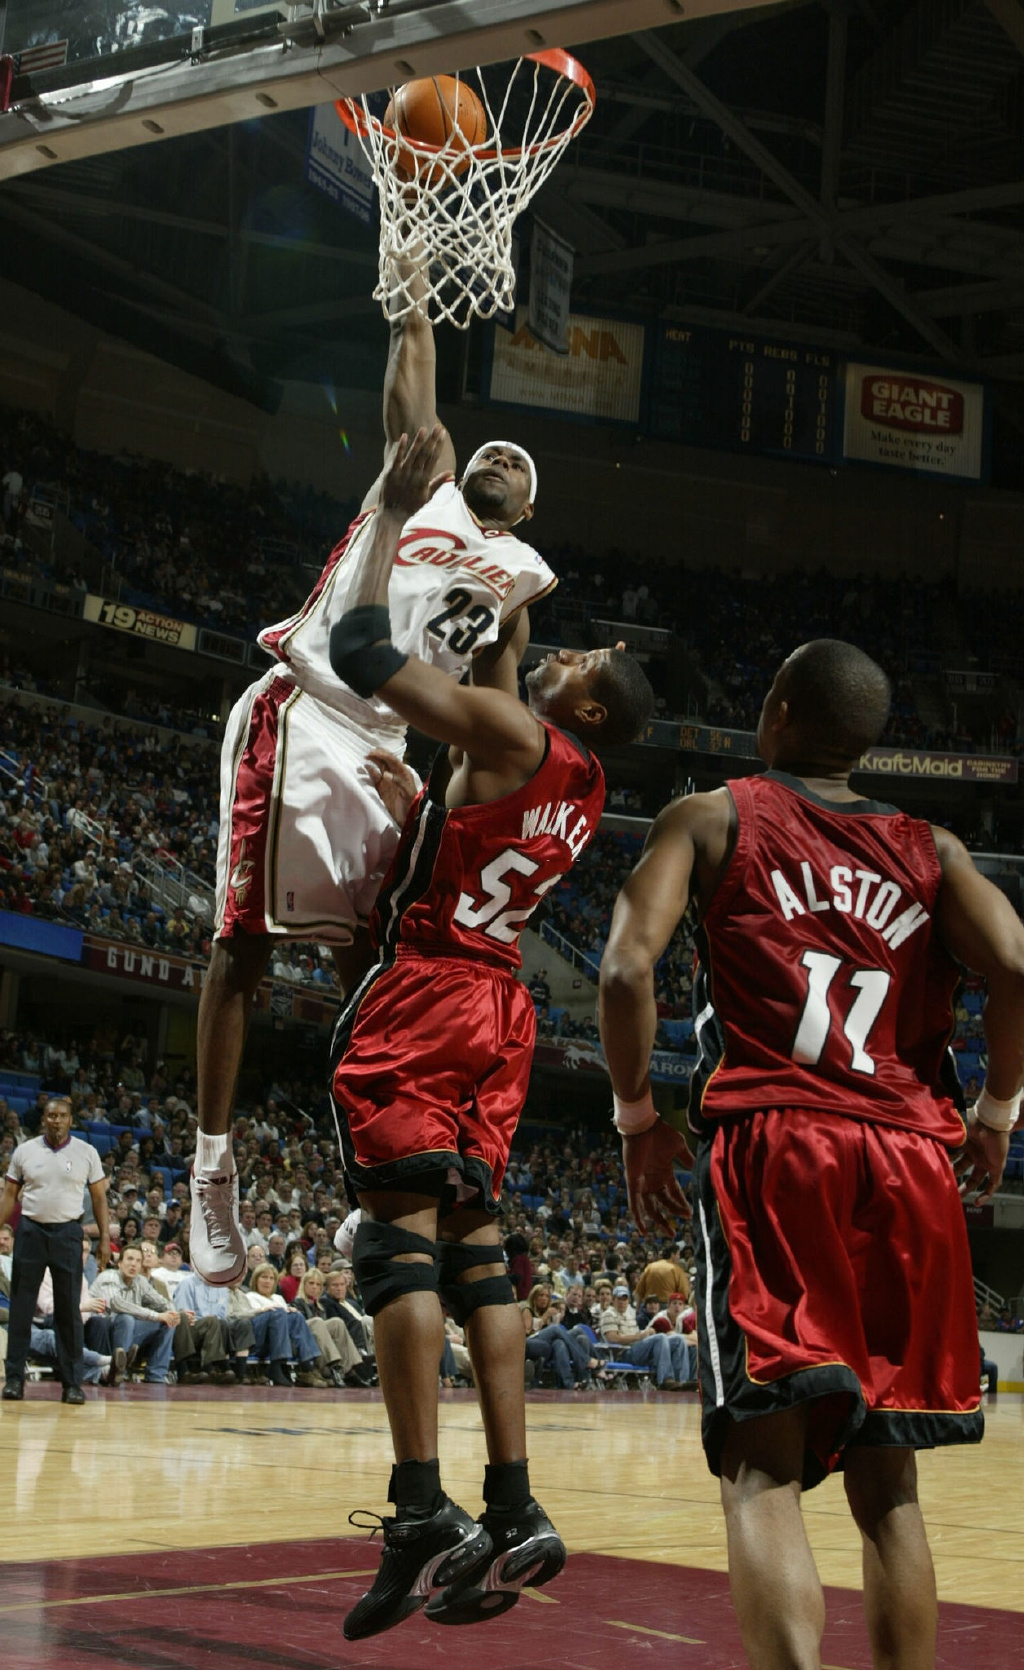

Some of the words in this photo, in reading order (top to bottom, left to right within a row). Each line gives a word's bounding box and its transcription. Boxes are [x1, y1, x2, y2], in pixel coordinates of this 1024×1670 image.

[509, 322, 629, 367] MNA
[729, 339, 755, 354] PTS
[806, 352, 831, 367] FLS
[871, 381, 954, 410] GIANT
[872, 400, 952, 428] EAGLE
[871, 430, 900, 445] Make
[903, 437, 933, 453] every
[935, 441, 956, 456] day
[879, 447, 906, 459] taste
[101, 601, 137, 629] 19
[136, 611, 184, 633] ACTION
[425, 588, 495, 655] 23
[134, 621, 181, 644] NEWS
[680, 725, 699, 739] DET
[859, 752, 963, 777] KraftMaid
[453, 848, 563, 944] 52
[770, 861, 931, 951] ALSTON
[107, 946, 170, 981] GUND
[790, 949, 892, 1076] 11
